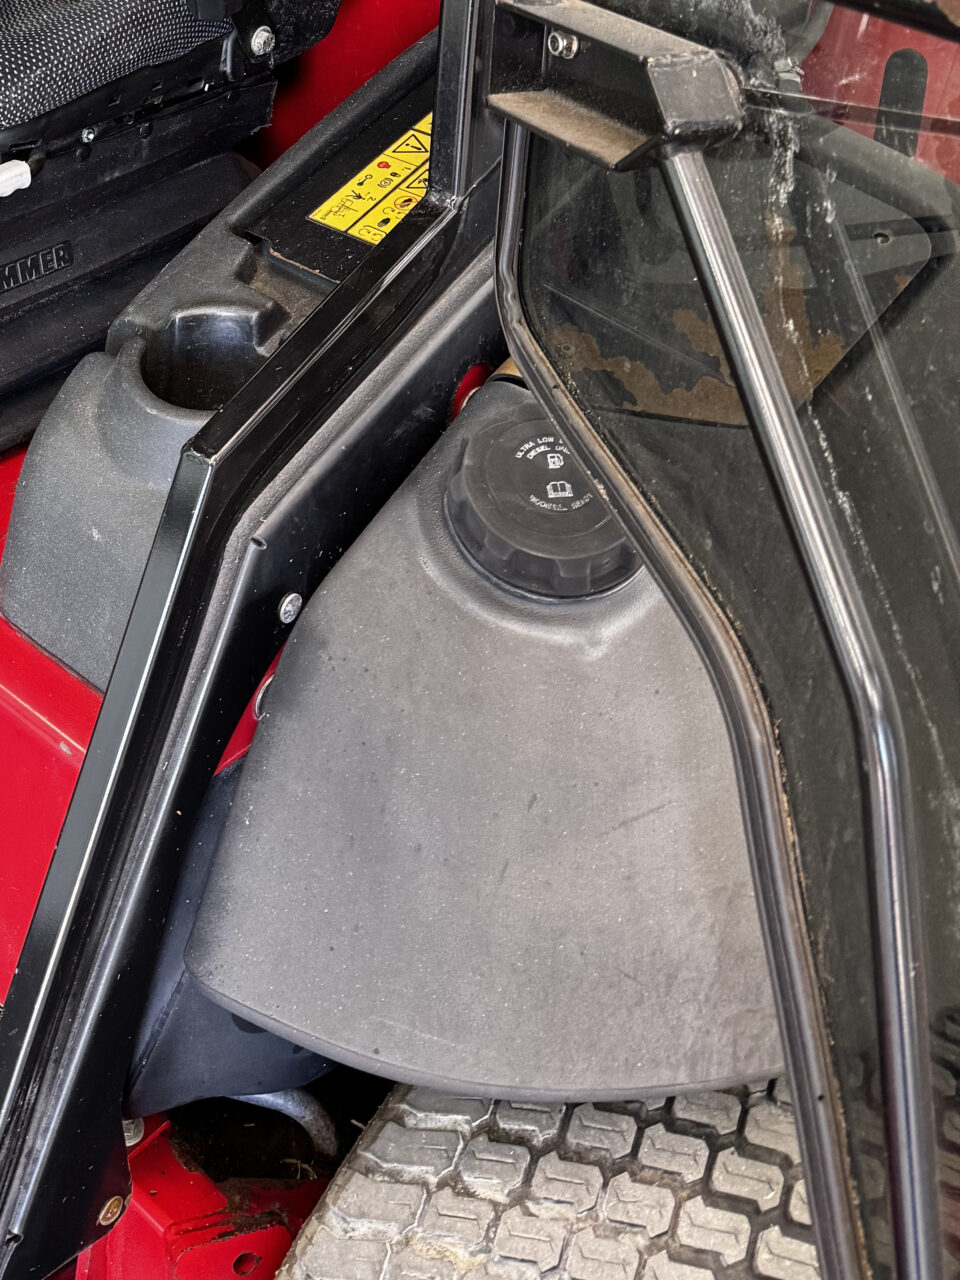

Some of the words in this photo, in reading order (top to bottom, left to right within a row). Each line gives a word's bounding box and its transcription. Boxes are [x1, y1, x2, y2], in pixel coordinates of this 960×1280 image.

[515, 440, 536, 459] ULTRA
[537, 436, 555, 444] LOW
[526, 445, 551, 460] DIESEL
